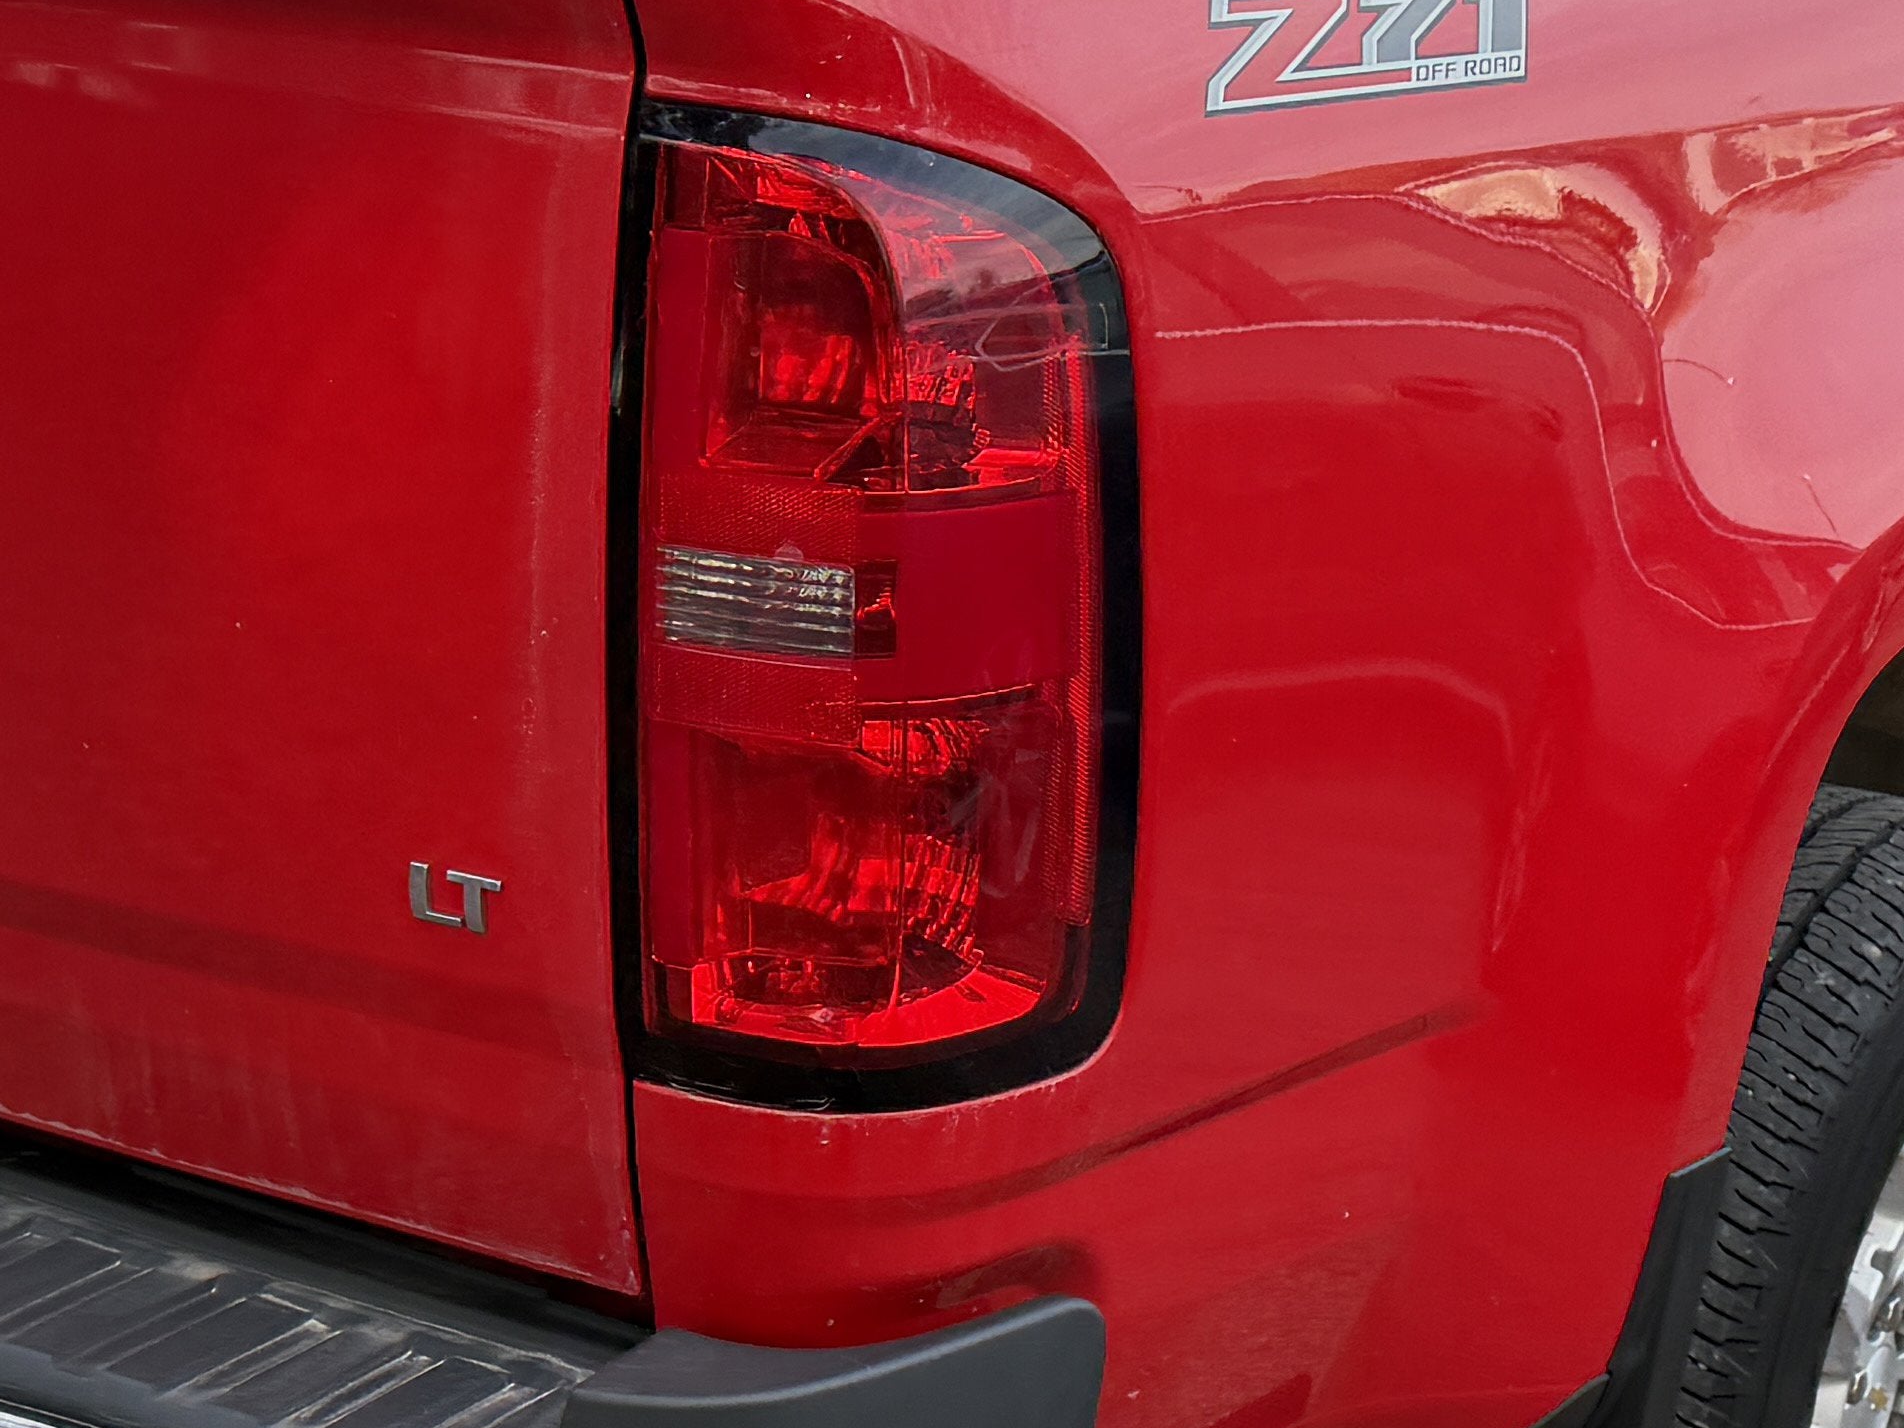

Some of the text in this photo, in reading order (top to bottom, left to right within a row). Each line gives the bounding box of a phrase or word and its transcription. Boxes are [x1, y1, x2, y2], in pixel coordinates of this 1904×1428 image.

[1415, 55, 1522, 82] OFF ROAD
[408, 861, 502, 935] LT
